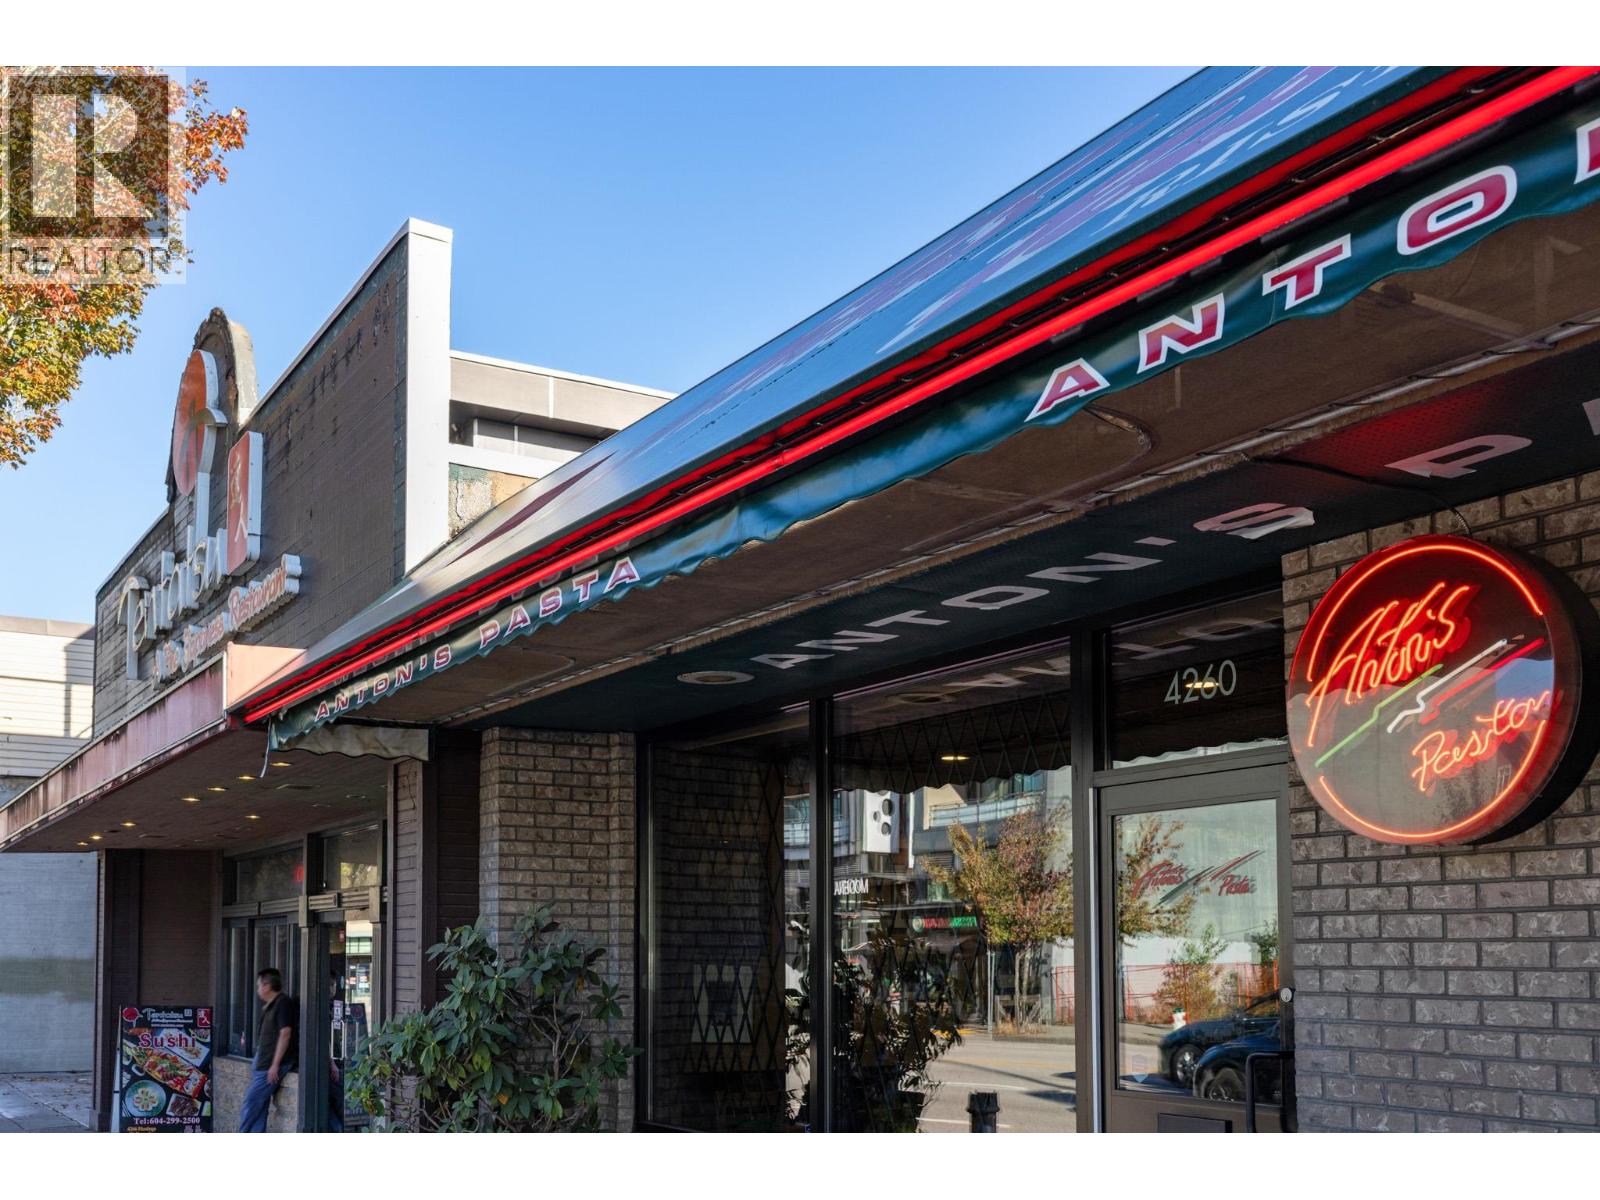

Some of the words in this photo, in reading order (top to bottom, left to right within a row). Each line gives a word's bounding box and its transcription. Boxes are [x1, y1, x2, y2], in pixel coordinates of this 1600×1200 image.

[313, 643, 452, 722] ANTON'S
[477, 556, 641, 649] PASTA
[749, 502, 1315, 670] ANTON'S
[1164, 659, 1237, 705] 4260
[138, 1032, 197, 1049] Sushi
